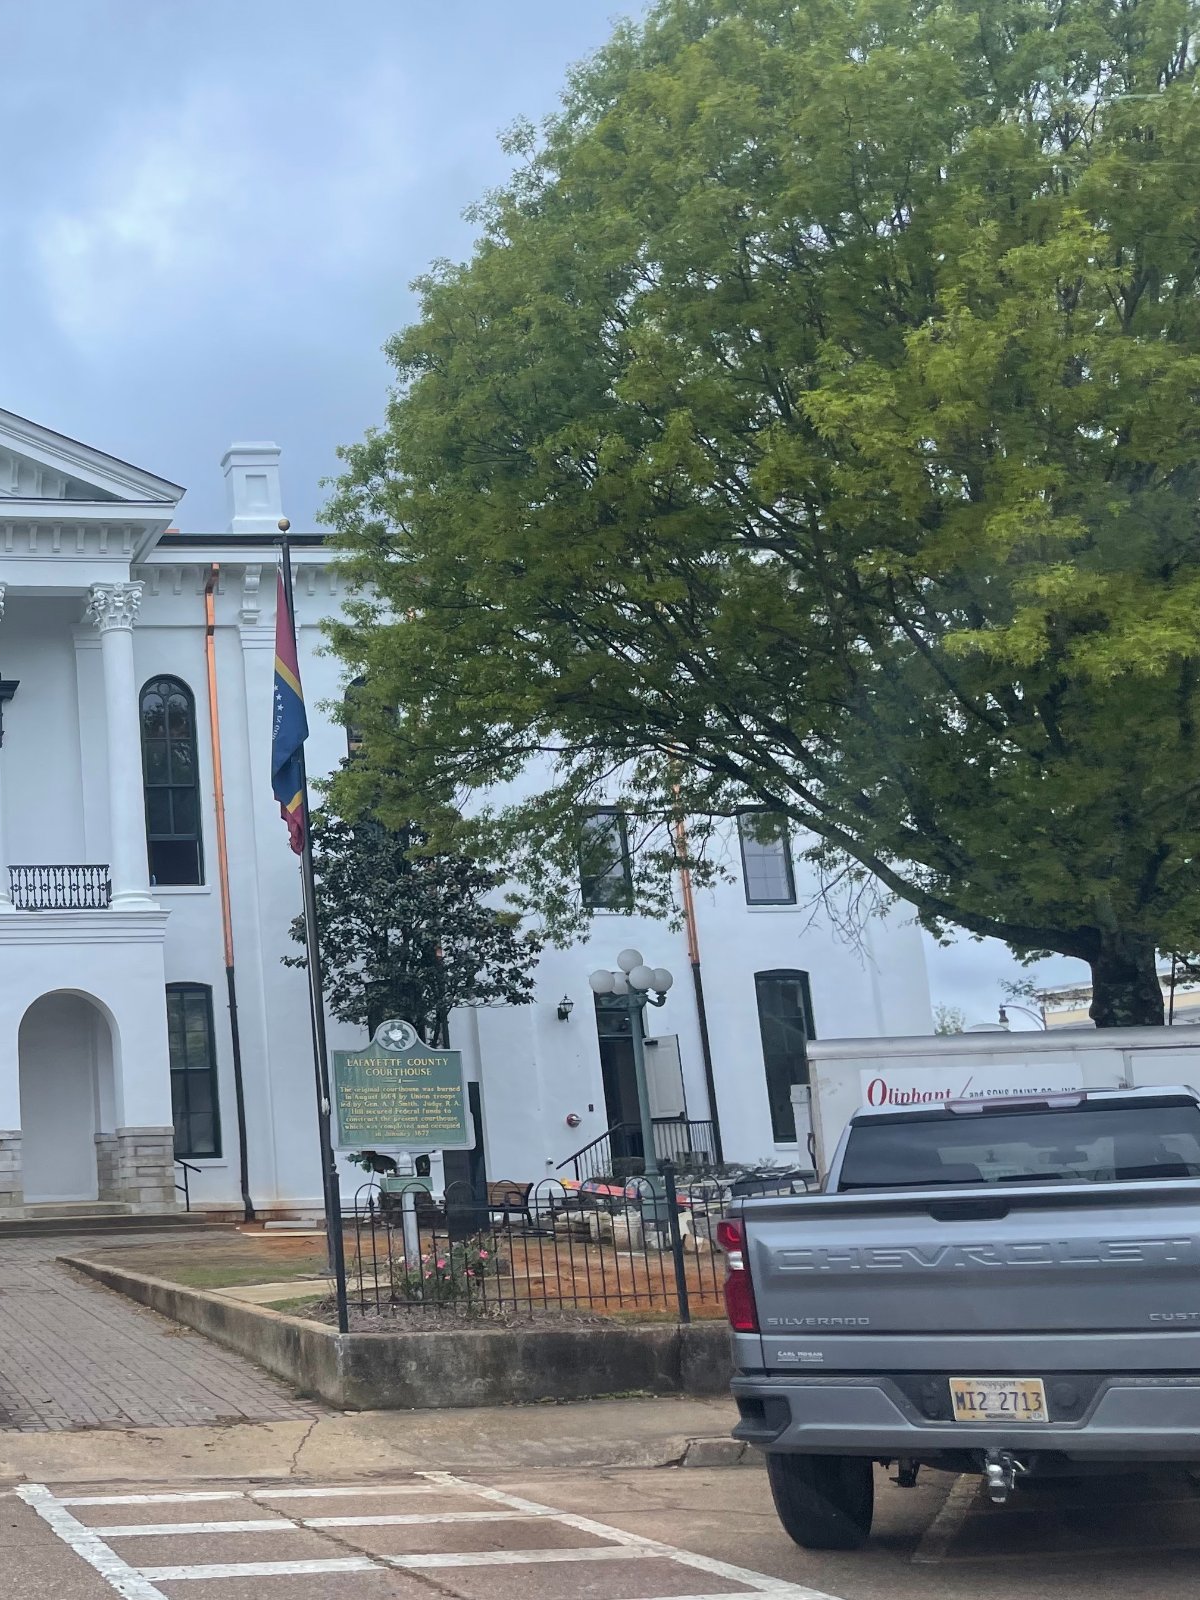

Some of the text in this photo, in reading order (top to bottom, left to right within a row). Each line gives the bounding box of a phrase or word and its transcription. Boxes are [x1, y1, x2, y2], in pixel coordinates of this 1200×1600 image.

[347, 1058, 448, 1066] LAFAYETTE COUNTY
[366, 1068, 432, 1076] COURTHOUSE
[354, 1086, 379, 1094] original
[399, 1093, 407, 1101] by
[423, 1100, 442, 1109] Judge
[776, 1238, 1192, 1270] CHEVROLET
[767, 1317, 870, 1325] SILVERADO
[955, 1391, 1042, 1411] MI2 2713
